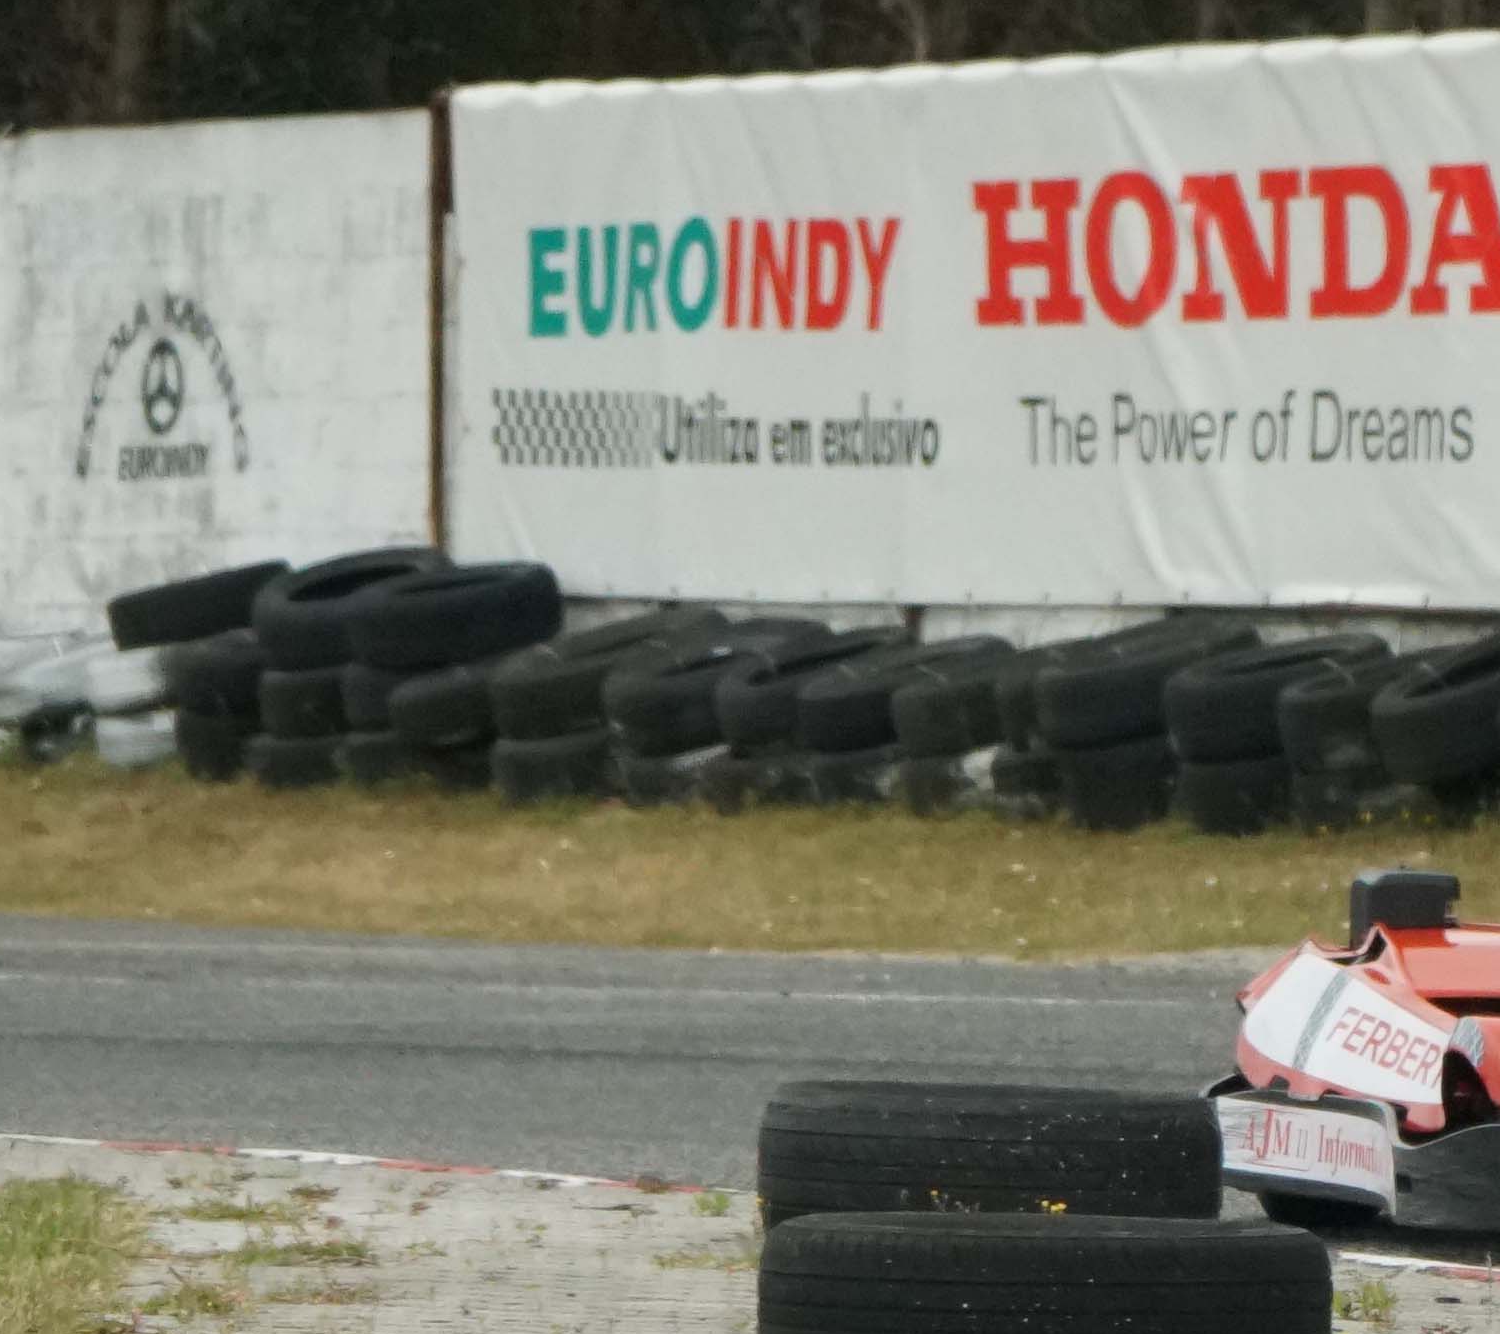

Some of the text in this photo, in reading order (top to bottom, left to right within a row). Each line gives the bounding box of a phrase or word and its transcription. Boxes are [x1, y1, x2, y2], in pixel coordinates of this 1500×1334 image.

[527, 217, 902, 338] EUROINDY
[660, 391, 939, 465] Utiliza em exclusivo
[1021, 389, 1474, 465] The Power of Dreams
